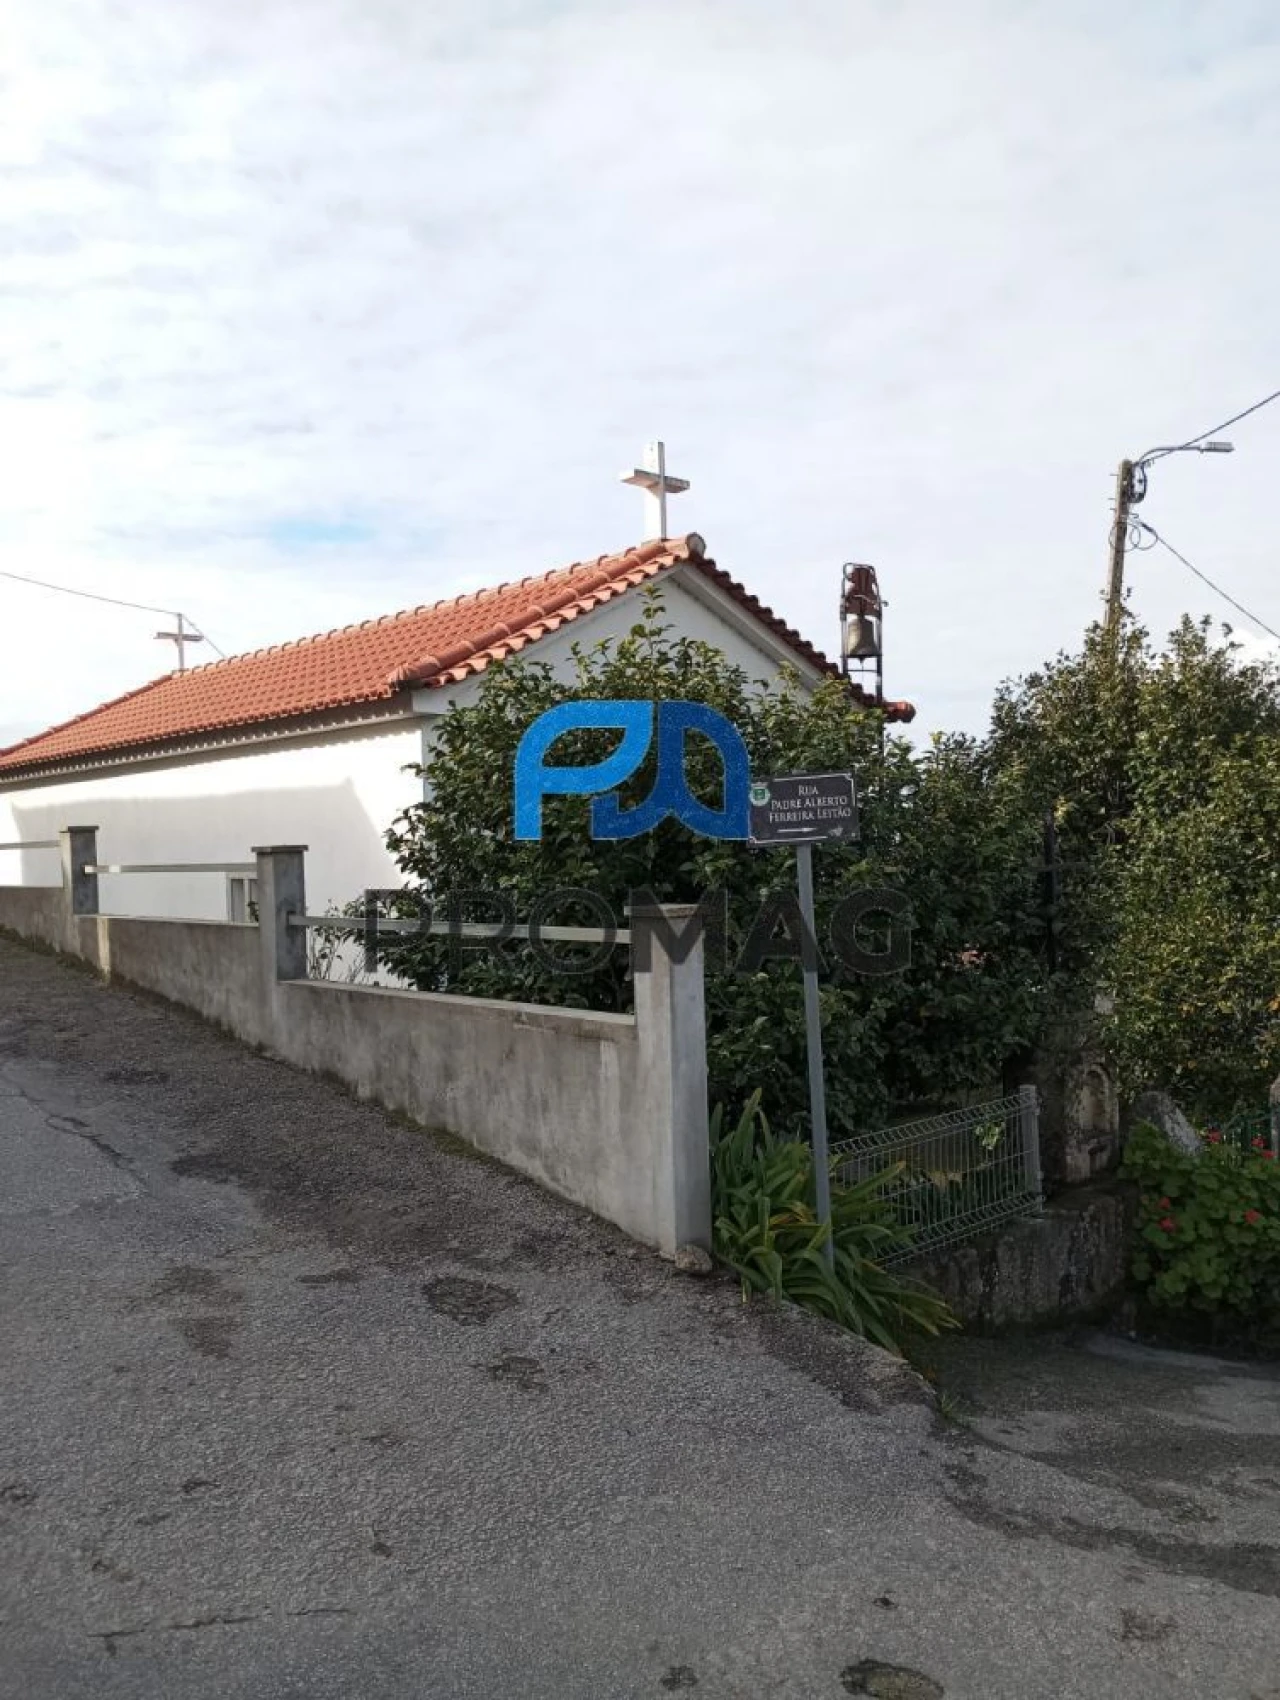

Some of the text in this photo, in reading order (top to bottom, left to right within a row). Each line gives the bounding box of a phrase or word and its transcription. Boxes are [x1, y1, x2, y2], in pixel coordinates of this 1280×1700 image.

[798, 785, 819, 796] RUA
[771, 796, 848, 811] PADRE ALBERTO
[769, 807, 851, 823] FERREIRA LEITÃO
